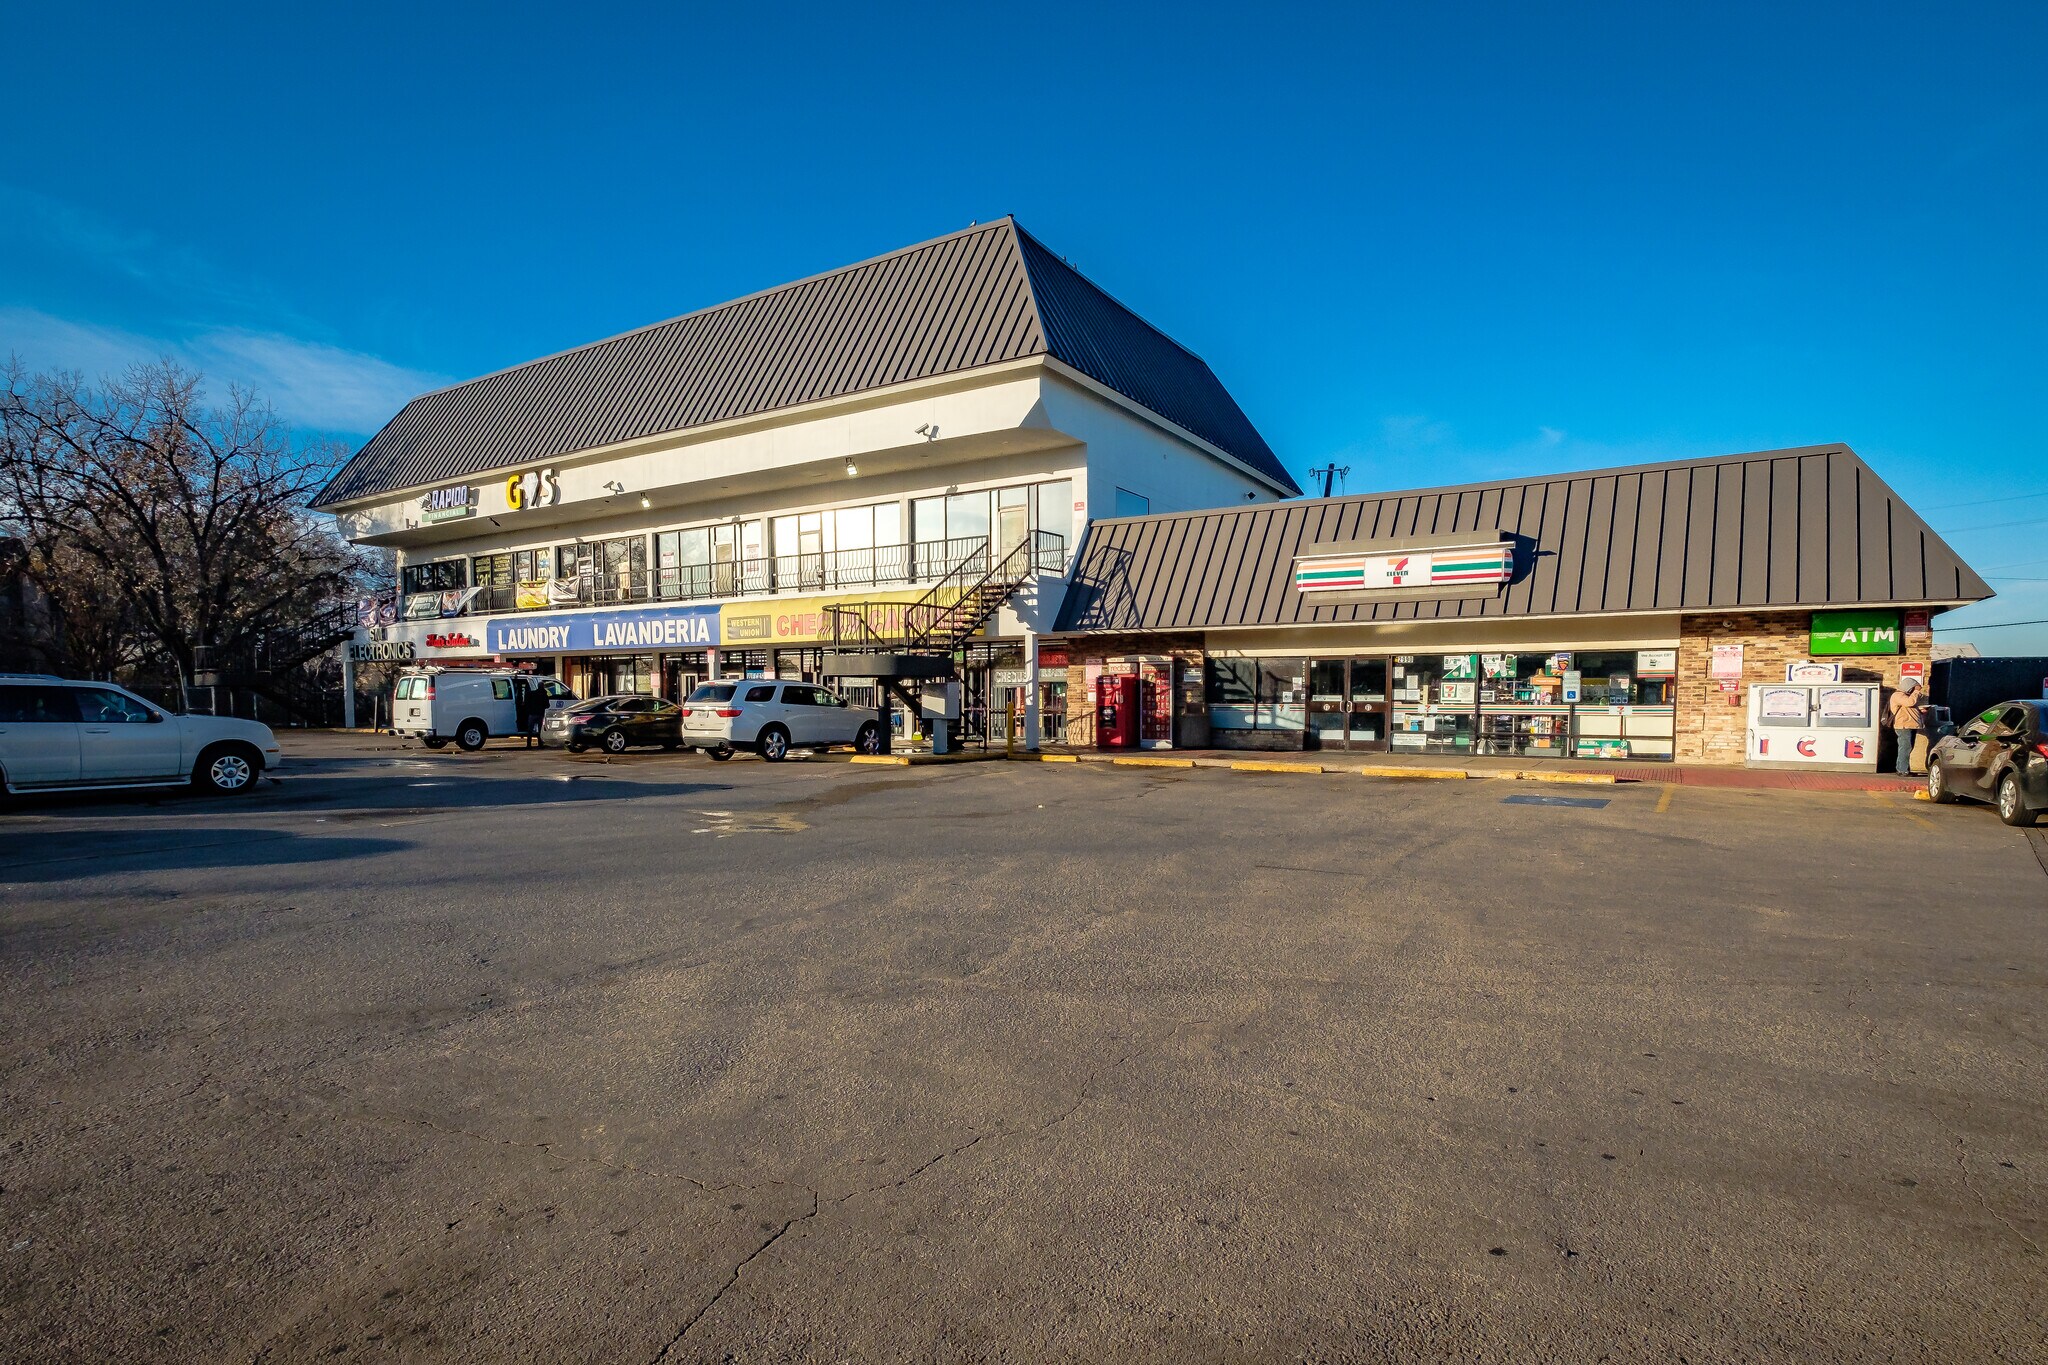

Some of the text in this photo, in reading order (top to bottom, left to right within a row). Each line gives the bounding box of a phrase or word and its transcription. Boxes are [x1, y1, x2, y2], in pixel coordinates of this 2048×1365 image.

[431, 485, 469, 511] RAPIDO
[428, 509, 461, 520] FINANCIAL
[1387, 556, 1409, 585] 7
[730, 619, 761, 627] WESTERN
[498, 618, 710, 650] LAUNDRY LAVANDERIA
[739, 628, 761, 637] UNION
[1840, 627, 1895, 643] ATM
[349, 641, 415, 660] ELECTRONICS
[1822, 689, 1863, 697] EMERGENCY
[1760, 735, 1865, 759] ICE
